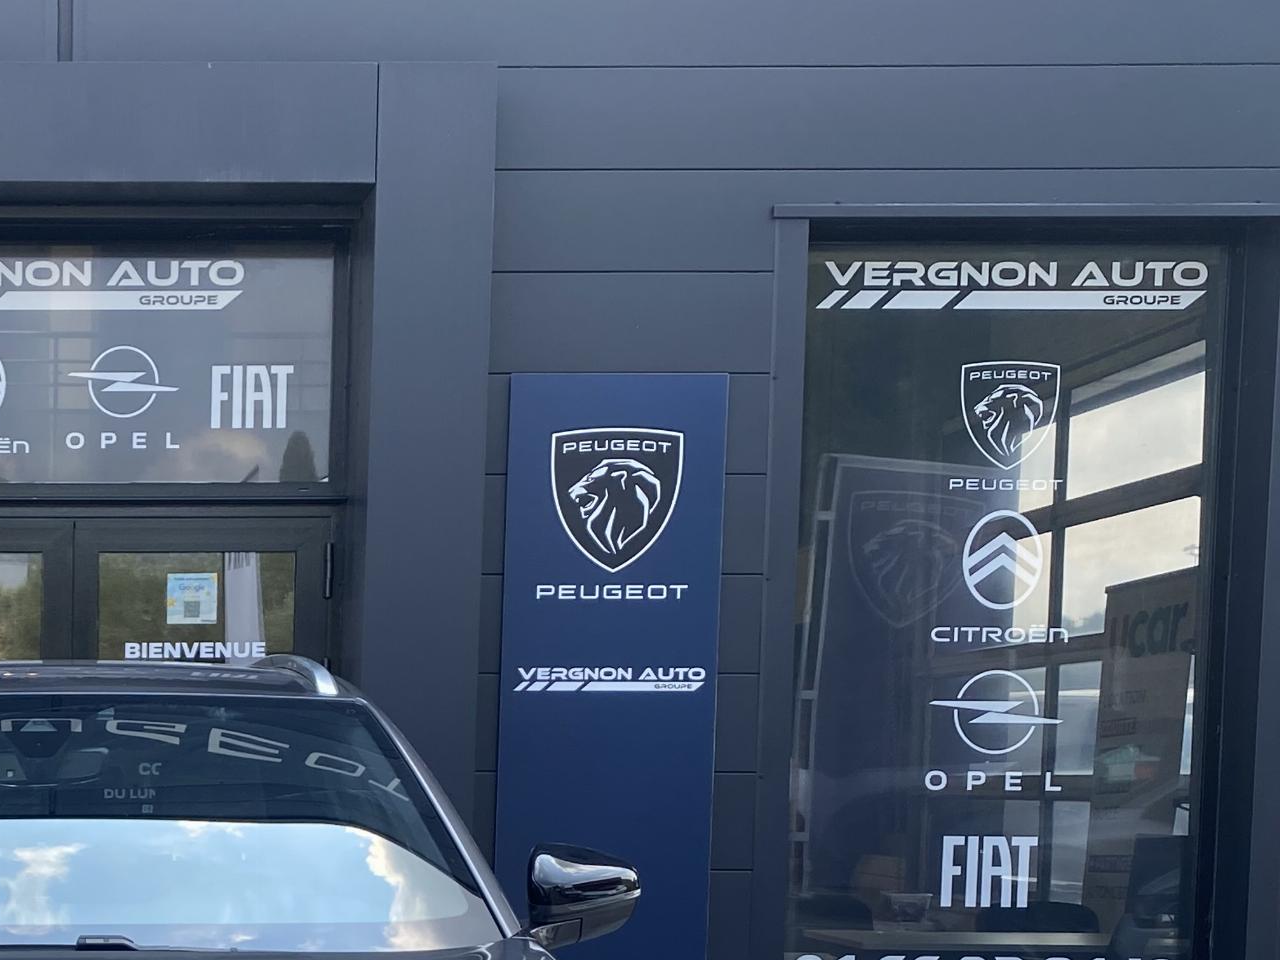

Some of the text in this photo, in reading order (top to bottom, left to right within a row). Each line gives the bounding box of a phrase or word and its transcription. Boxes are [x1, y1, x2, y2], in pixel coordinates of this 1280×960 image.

[106, 260, 245, 287] AUTO
[824, 261, 1209, 287] VERGNON AUTO
[138, 294, 219, 306] GROUPE
[1103, 294, 1182, 306] GROUPE
[969, 369, 1052, 382] PEUGEOT
[210, 365, 294, 429] FIAT
[65, 431, 180, 450] OPEL
[562, 440, 672, 454] PEUGEOT
[949, 477, 1064, 492] PEUGEOT
[536, 584, 689, 600] PEUGEOT
[124, 641, 267, 659] BIENVENUE
[517, 667, 706, 681] VERGNON AUTO
[924, 770, 1062, 792] OPEL
[103, 788, 126, 799] DU
[940, 835, 1038, 908] FIAT
